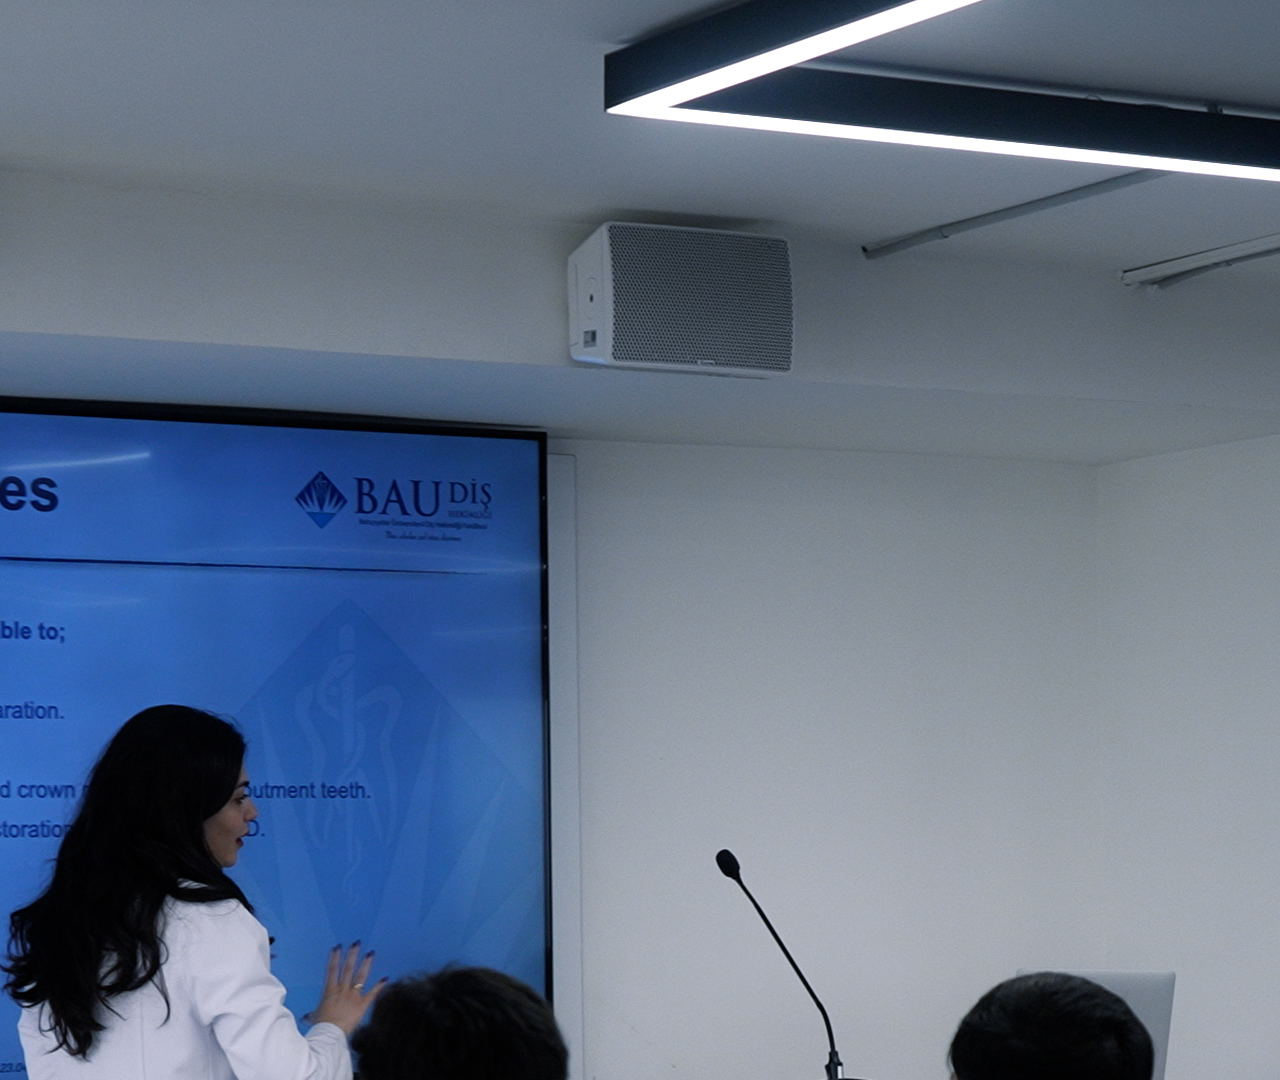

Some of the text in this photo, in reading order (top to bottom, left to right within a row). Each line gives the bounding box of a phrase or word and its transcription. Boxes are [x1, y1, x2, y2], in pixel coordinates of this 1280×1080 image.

[353, 477, 492, 517] BAU DİŞ
[37, 622, 66, 644] to;
[17, 784, 77, 800] crown
[321, 782, 371, 799] teeth.
